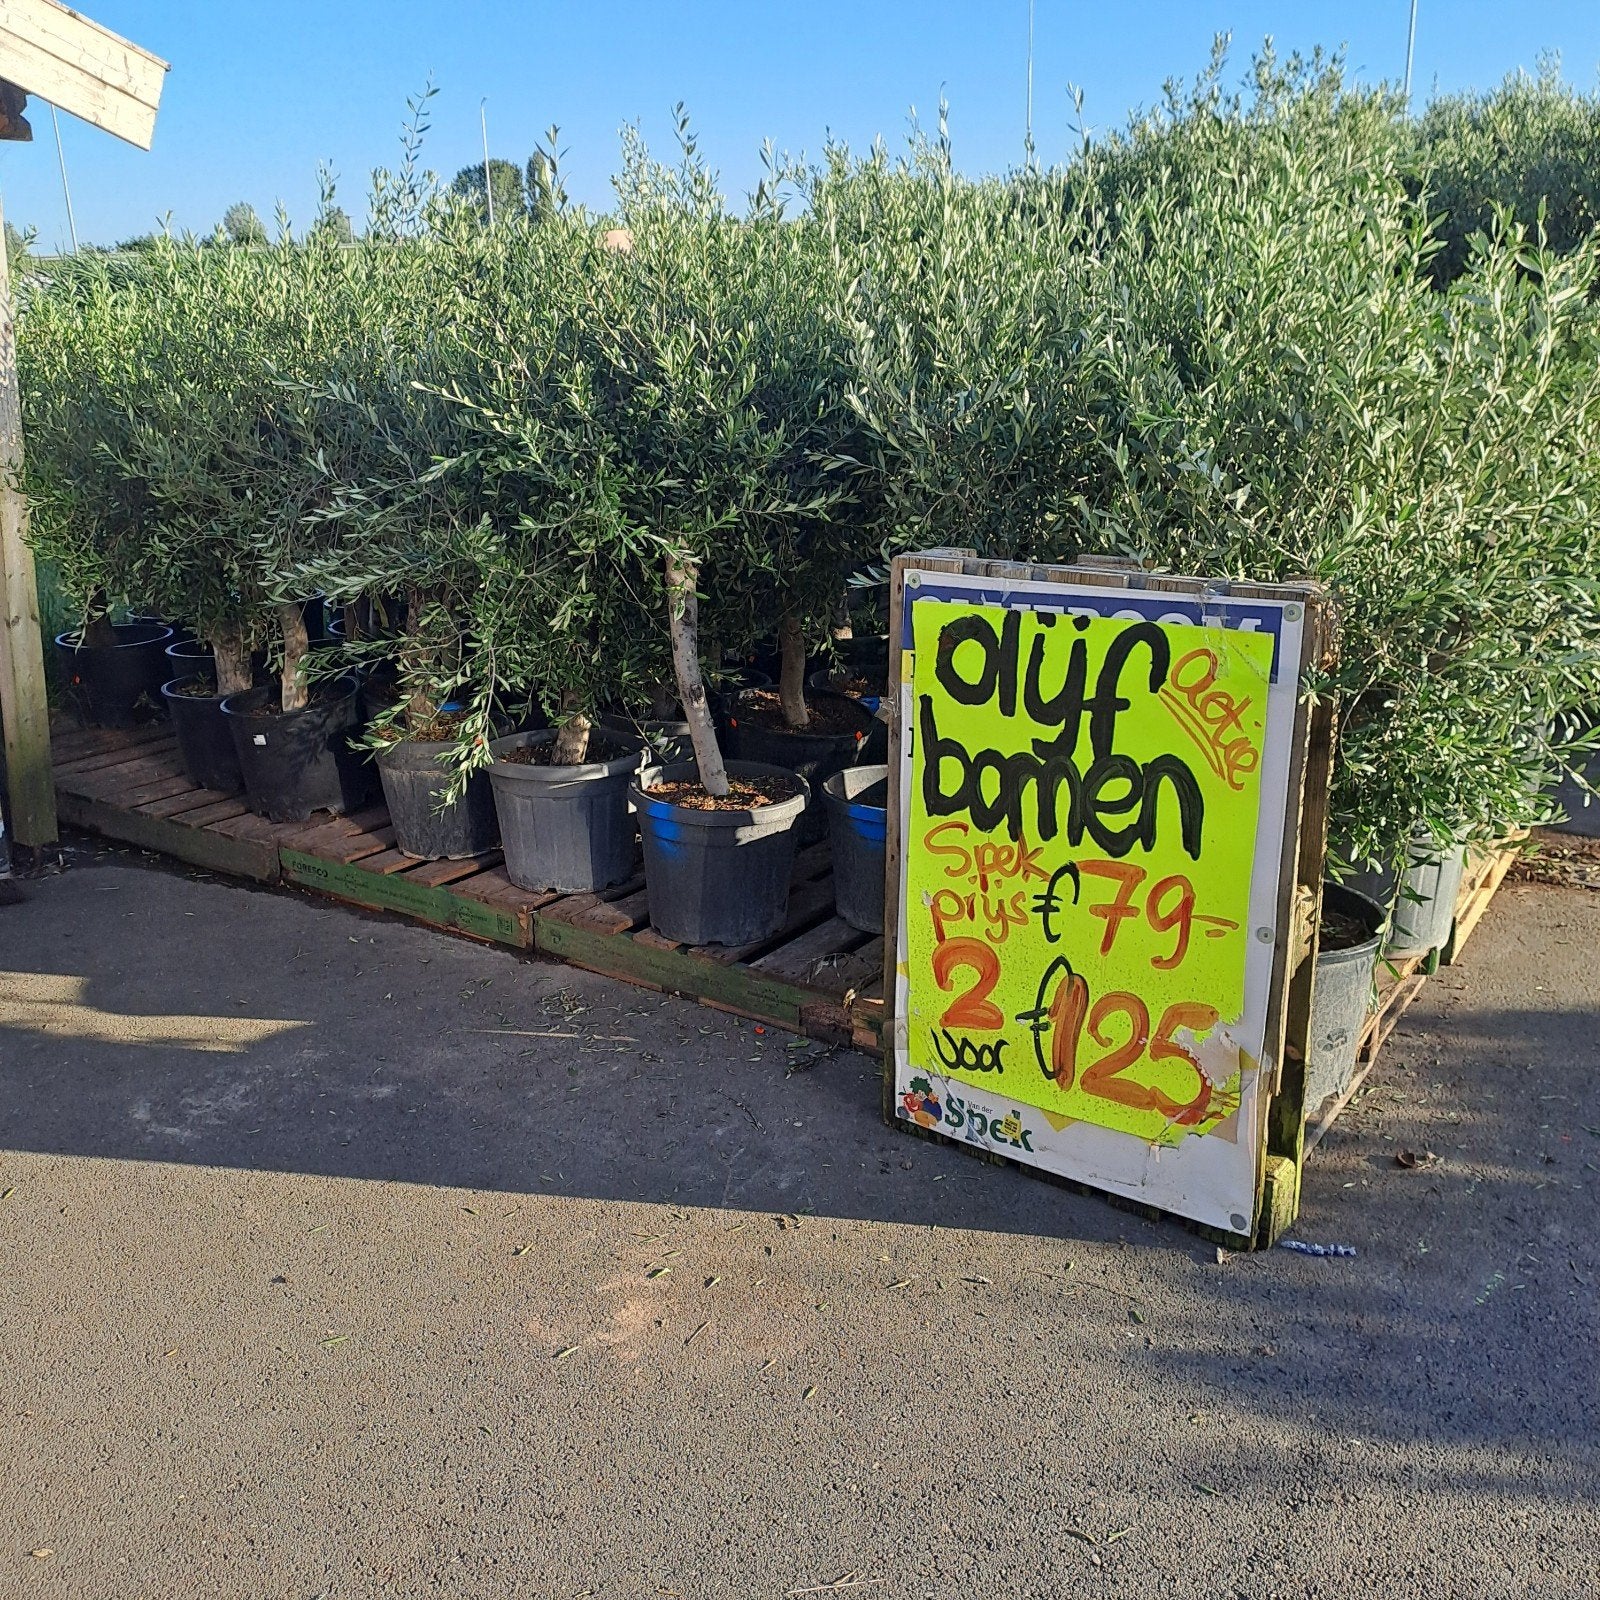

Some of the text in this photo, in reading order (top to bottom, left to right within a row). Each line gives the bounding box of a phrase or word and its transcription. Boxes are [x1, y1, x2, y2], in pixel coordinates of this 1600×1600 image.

[918, 694, 1204, 860] bomen
[931, 936, 1004, 1030] 2
[944, 1092, 1035, 1153] Spek
[967, 1100, 994, 1115] Van der
